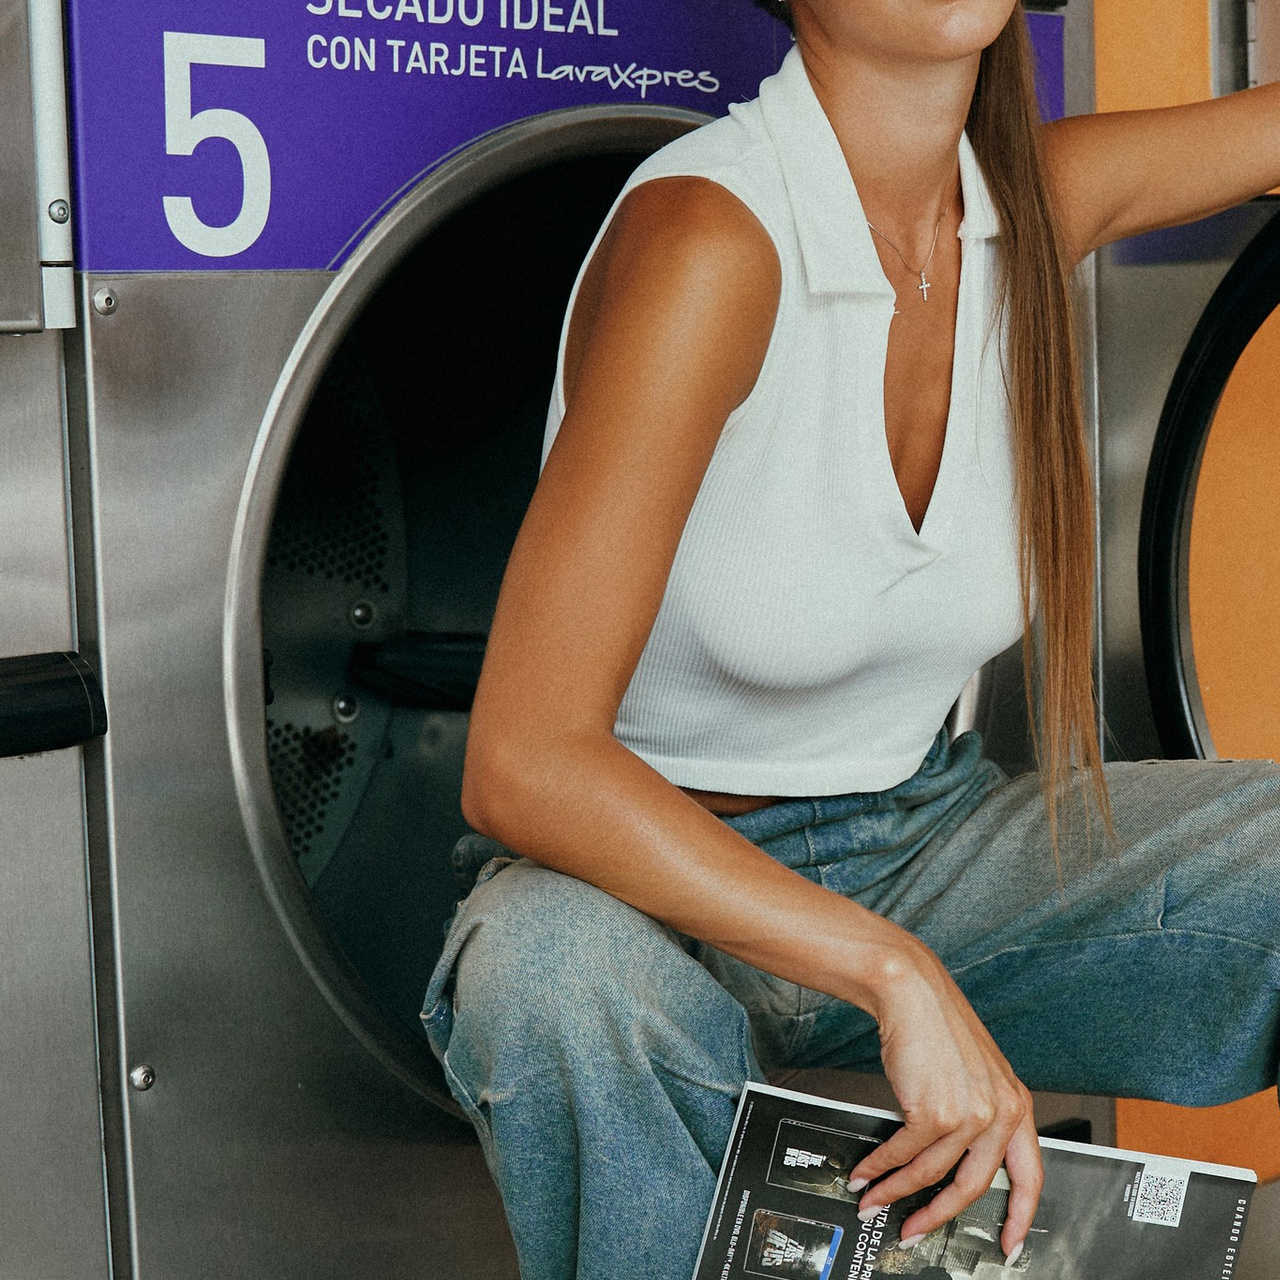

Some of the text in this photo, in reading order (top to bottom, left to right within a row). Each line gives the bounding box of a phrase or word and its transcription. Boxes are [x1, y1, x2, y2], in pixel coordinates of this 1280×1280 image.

[307, 34, 721, 99] CON TARJETA LavaXpres
[162, 31, 272, 258] 5
[795, 1149, 812, 1170] LAST
[1229, 1199, 1247, 1242] CUANDO
[764, 1228, 790, 1252] OF
[781, 1237, 800, 1265] LAST
[869, 1230, 883, 1247] DE
[760, 1246, 785, 1271] US
[865, 1247, 879, 1261] LA
